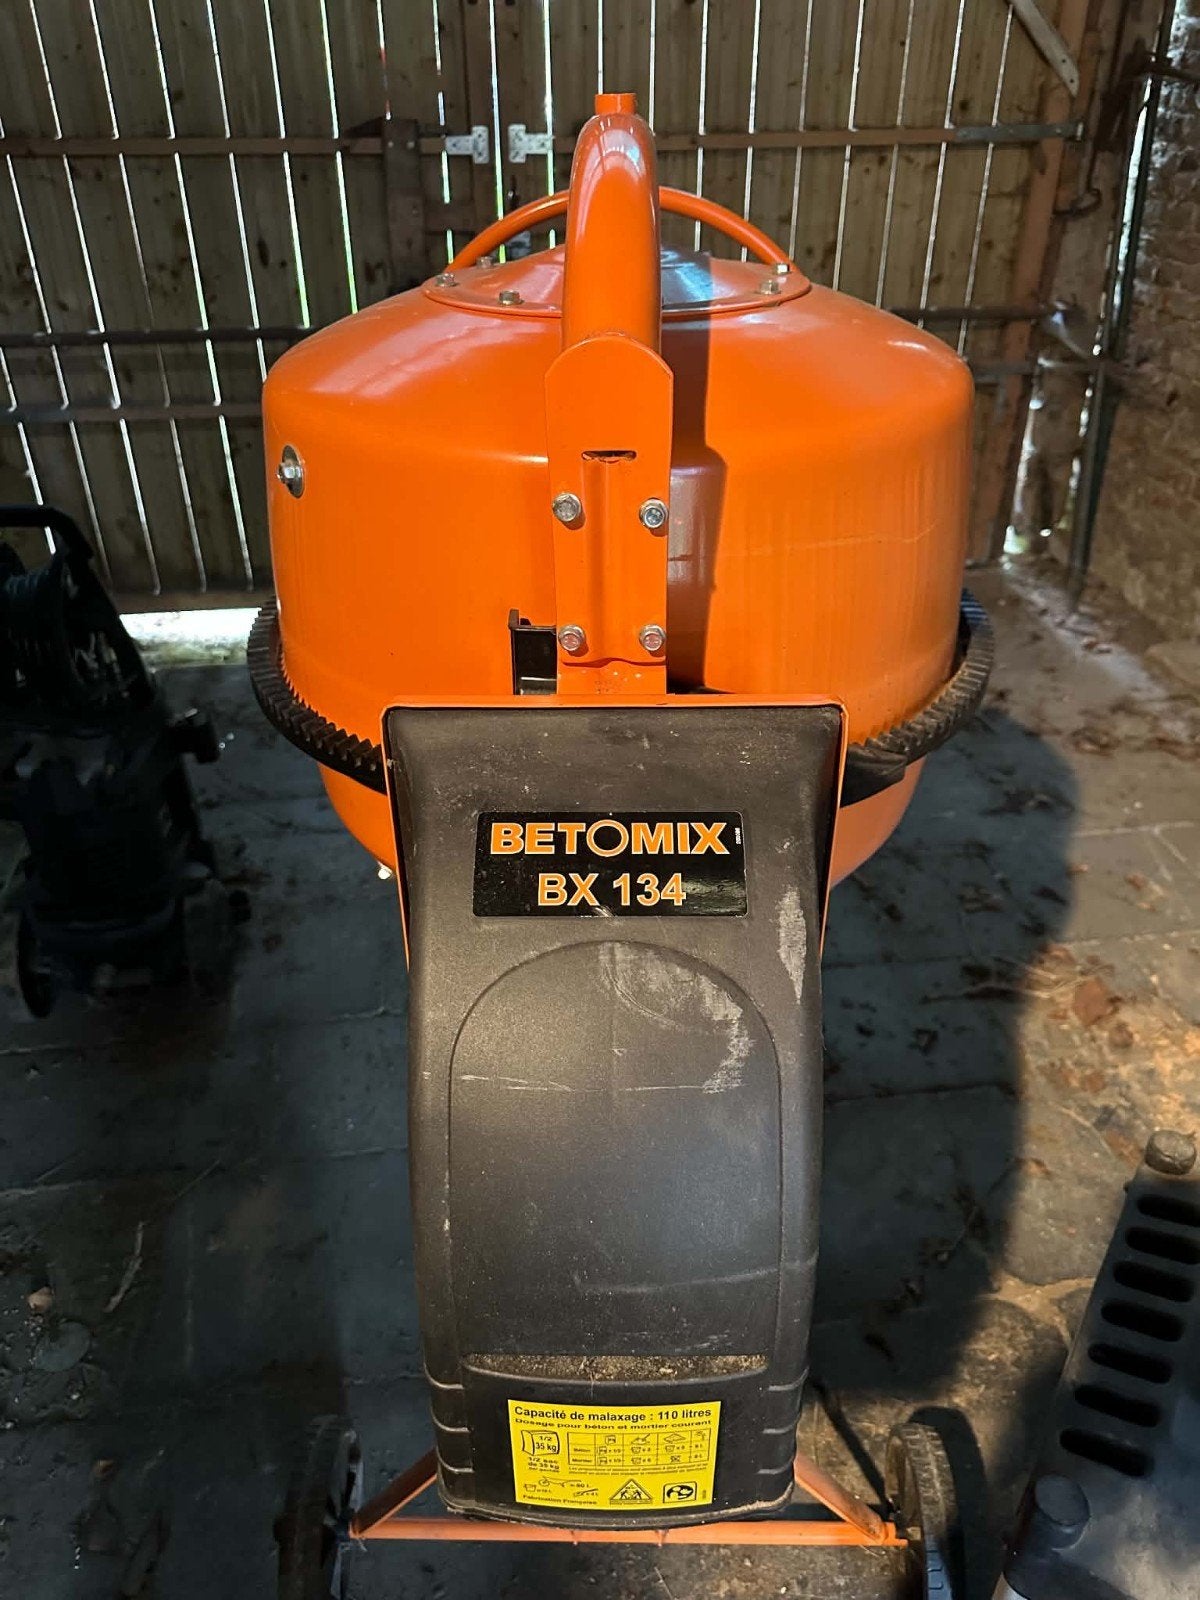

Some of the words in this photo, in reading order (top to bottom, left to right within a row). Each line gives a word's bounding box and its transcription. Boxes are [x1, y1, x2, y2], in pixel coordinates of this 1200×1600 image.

[490, 819, 730, 857] BETOMIX
[538, 873, 600, 906] BX
[612, 873, 686, 906] 134
[515, 1406, 566, 1419] Capacité
[570, 1411, 584, 1420] de
[588, 1412, 646, 1423] malaxage
[658, 1410, 678, 1420] 110
[682, 1409, 712, 1419] litres
[515, 1418, 555, 1427] Dosage
[671, 1420, 712, 1428] courant
[535, 1442, 545, 1451] 35
[547, 1443, 557, 1452] kg
